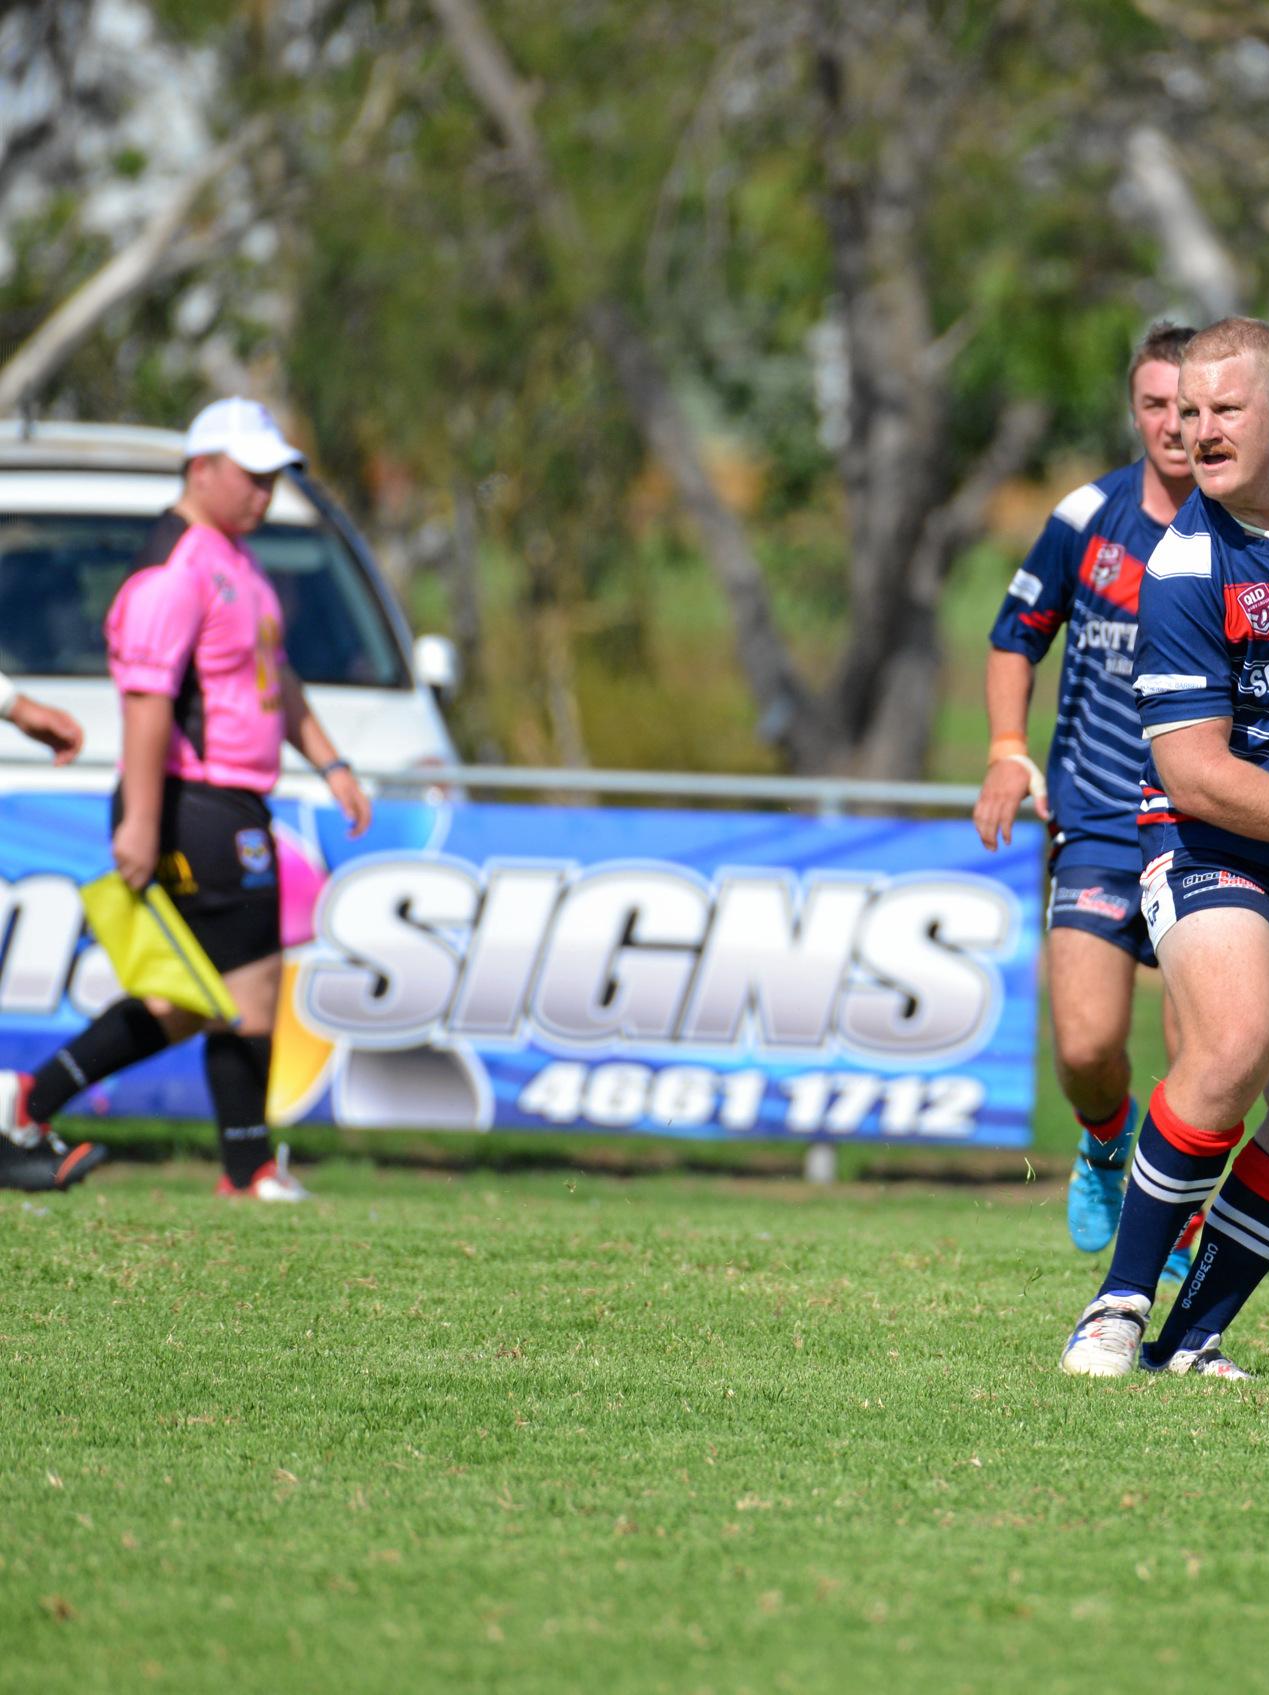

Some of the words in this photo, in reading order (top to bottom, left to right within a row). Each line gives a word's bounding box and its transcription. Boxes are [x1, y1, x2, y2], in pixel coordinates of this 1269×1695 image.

[1243, 588, 1266, 606] QLD
[302, 856, 1014, 1062] SIGNS
[518, 1060, 768, 1132] 4661
[782, 1071, 986, 1138] 1712
[1181, 1242, 1220, 1310] COWBOYS
